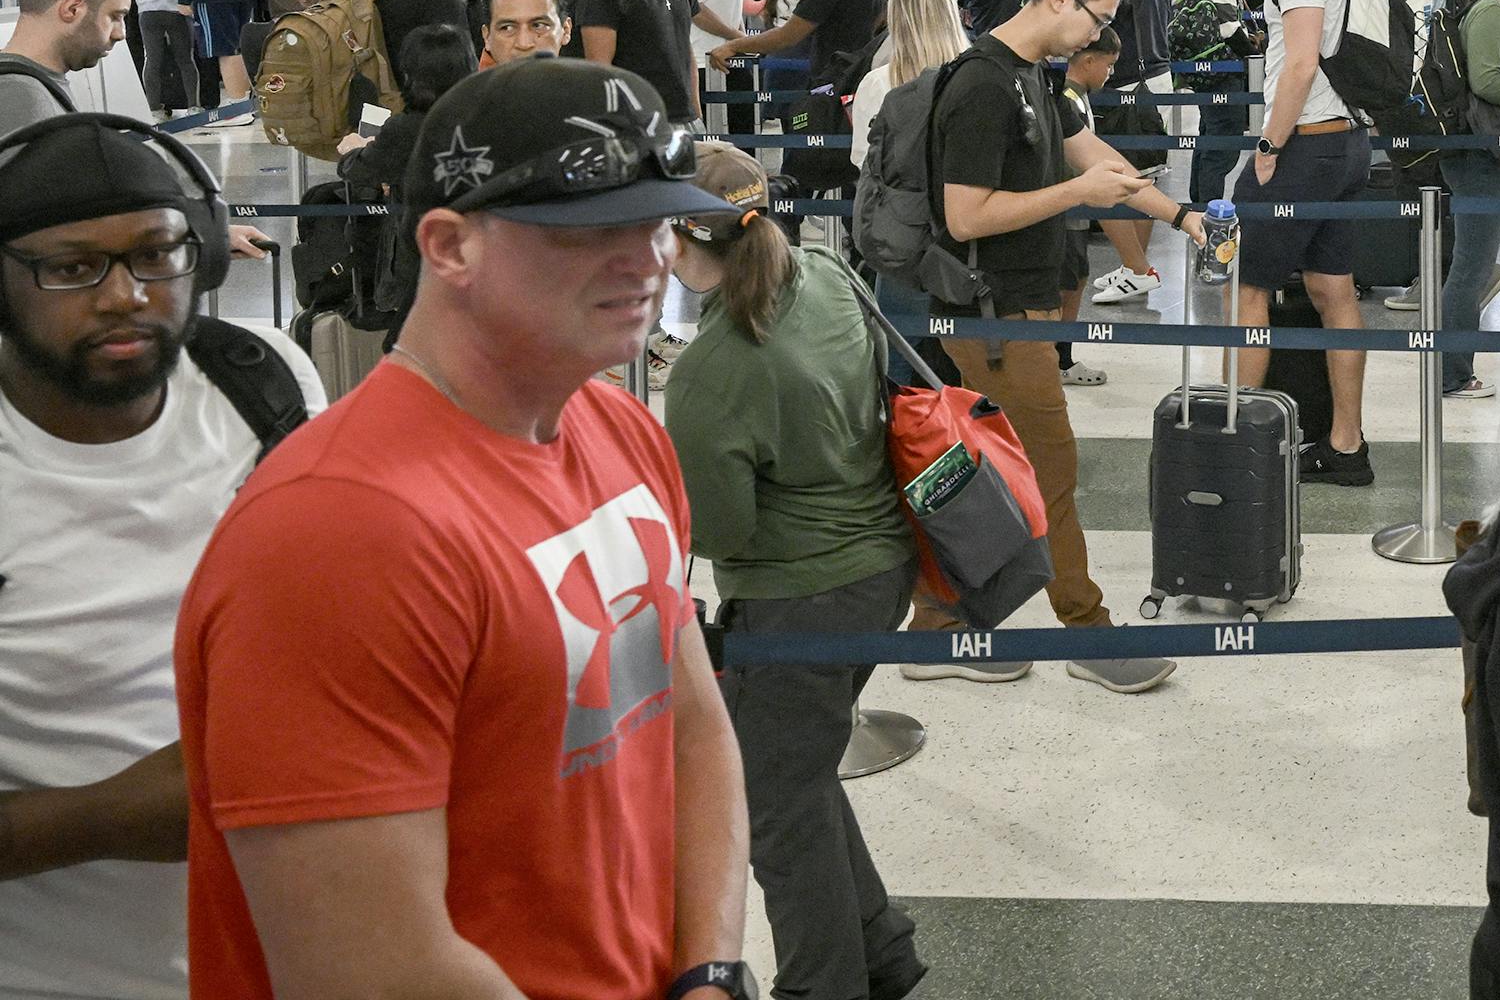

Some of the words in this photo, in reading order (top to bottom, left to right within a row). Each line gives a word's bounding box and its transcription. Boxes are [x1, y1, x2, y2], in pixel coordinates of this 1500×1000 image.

[1195, 62, 1212, 72] IAH
[757, 92, 772, 102] IAH
[1120, 94, 1136, 104] IAH
[1213, 93, 1228, 103] IAH
[807, 136, 824, 147] IAH
[1179, 137, 1196, 148] IAH
[1393, 138, 1409, 149] IAH
[236, 206, 257, 216] IAH
[366, 205, 388, 216] IAH
[774, 201, 794, 214] IAH
[1274, 204, 1295, 217] IAH
[1400, 203, 1420, 215] IAH
[929, 318, 955, 335] IAH
[1087, 324, 1113, 341] IAH
[1246, 328, 1271, 346] IAH
[1408, 331, 1434, 348] IAH
[924, 465, 970, 505] GHIRARDELLI
[1215, 626, 1255, 651] IAH
[951, 633, 992, 658] IAH
